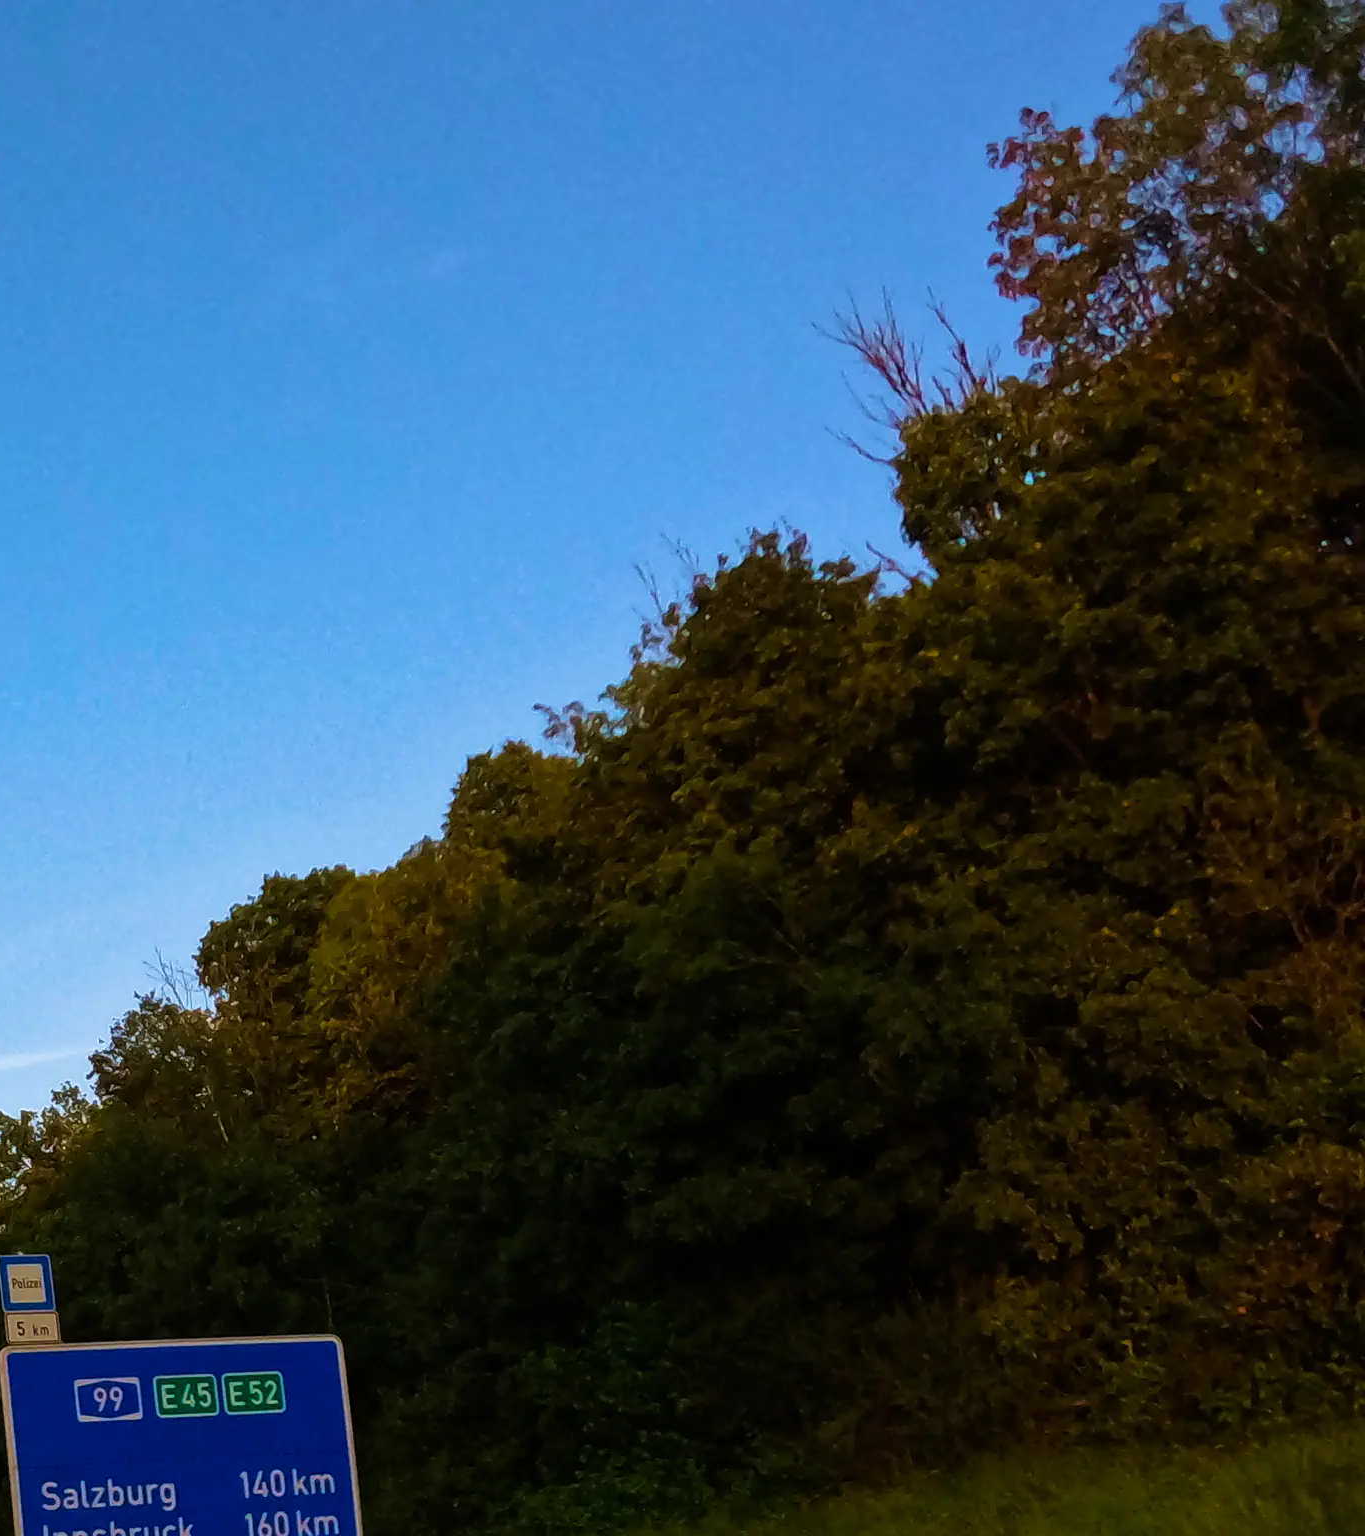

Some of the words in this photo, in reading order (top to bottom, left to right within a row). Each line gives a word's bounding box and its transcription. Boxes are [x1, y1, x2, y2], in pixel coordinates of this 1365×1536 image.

[11, 1277, 42, 1289] Polizei
[16, 1321, 26, 1336] 5
[32, 1324, 50, 1336] km
[93, 1387, 123, 1412] 99
[41, 1478, 177, 1511] Salzburg
[239, 1469, 286, 1499] 140
[292, 1468, 336, 1496] km
